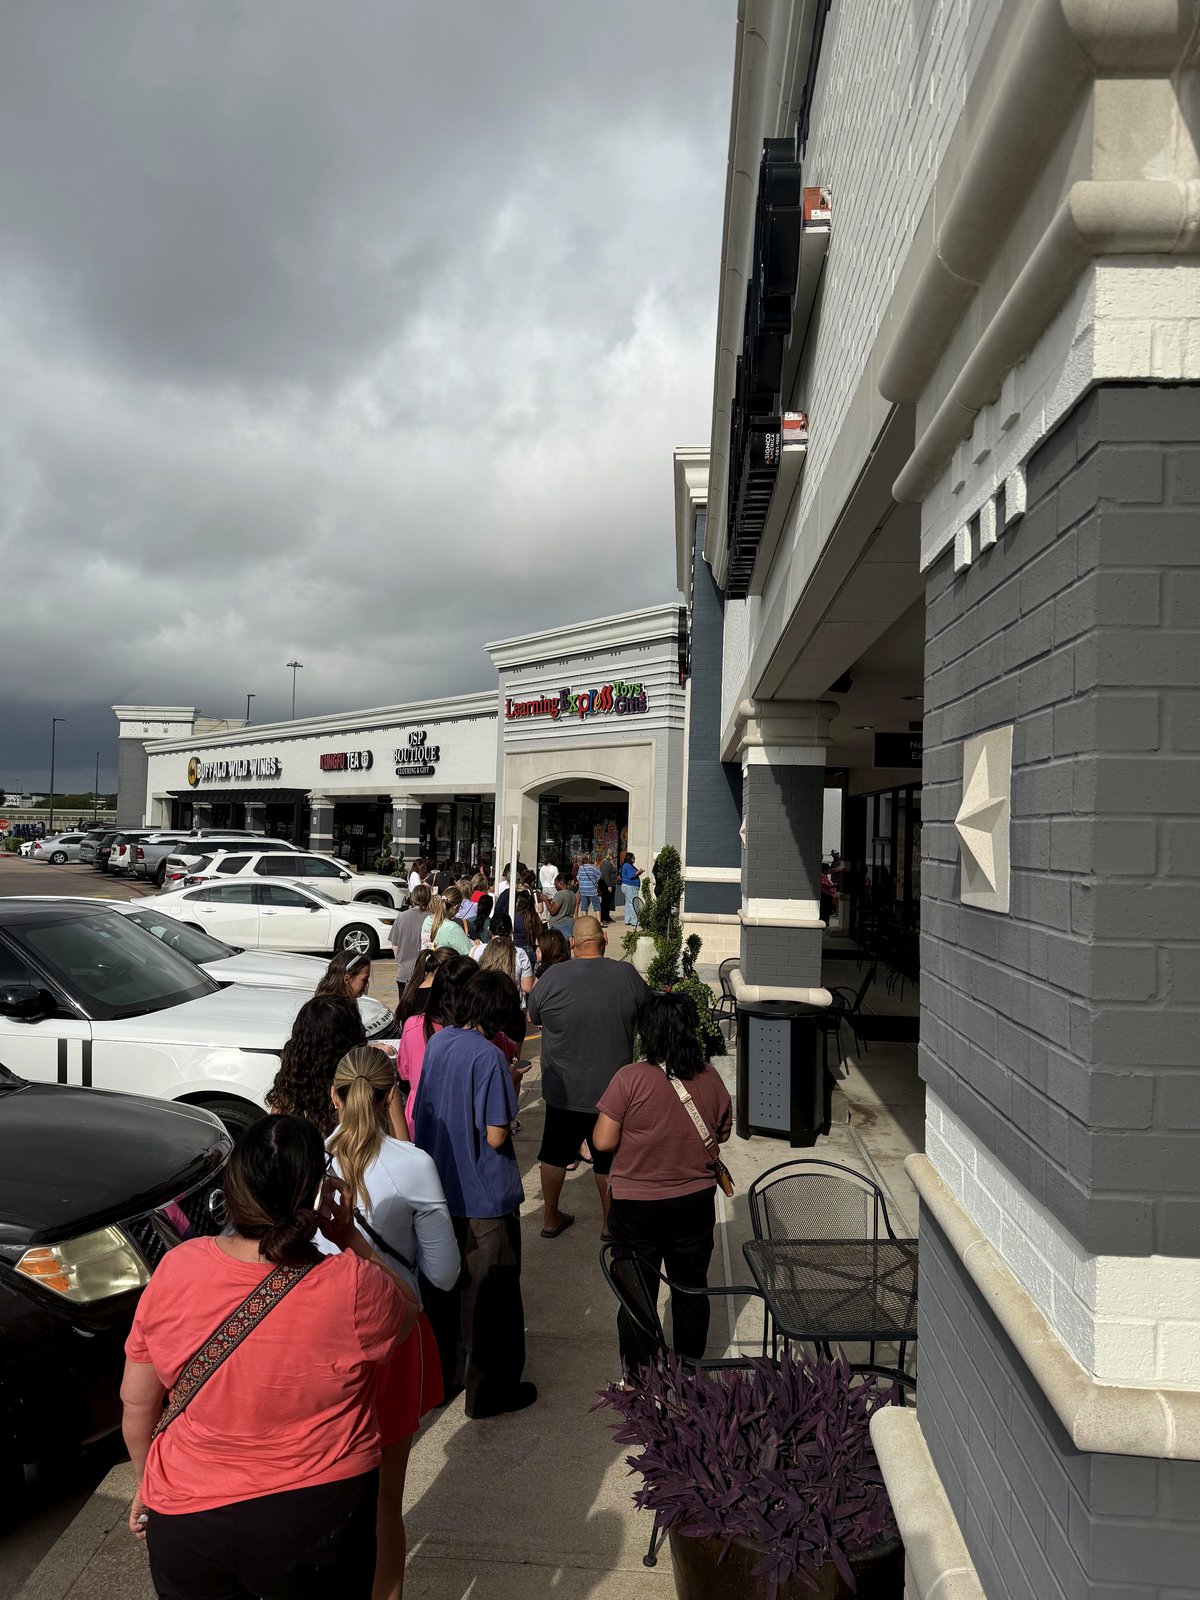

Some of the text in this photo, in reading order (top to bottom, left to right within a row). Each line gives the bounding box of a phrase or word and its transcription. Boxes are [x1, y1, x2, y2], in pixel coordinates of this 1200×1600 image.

[613, 681, 642, 698] Toys
[505, 695, 560, 718] Learning
[558, 685, 613, 718] Express
[615, 697, 646, 714] Gifts
[347, 751, 359, 769] TEA
[394, 746, 437, 764] BOUTIQUE
[197, 761, 227, 778] BUFFALO
[228, 759, 248, 777] WILD
[250, 757, 276, 775] WINGS
[686, 1102, 702, 1126] CHAEL
